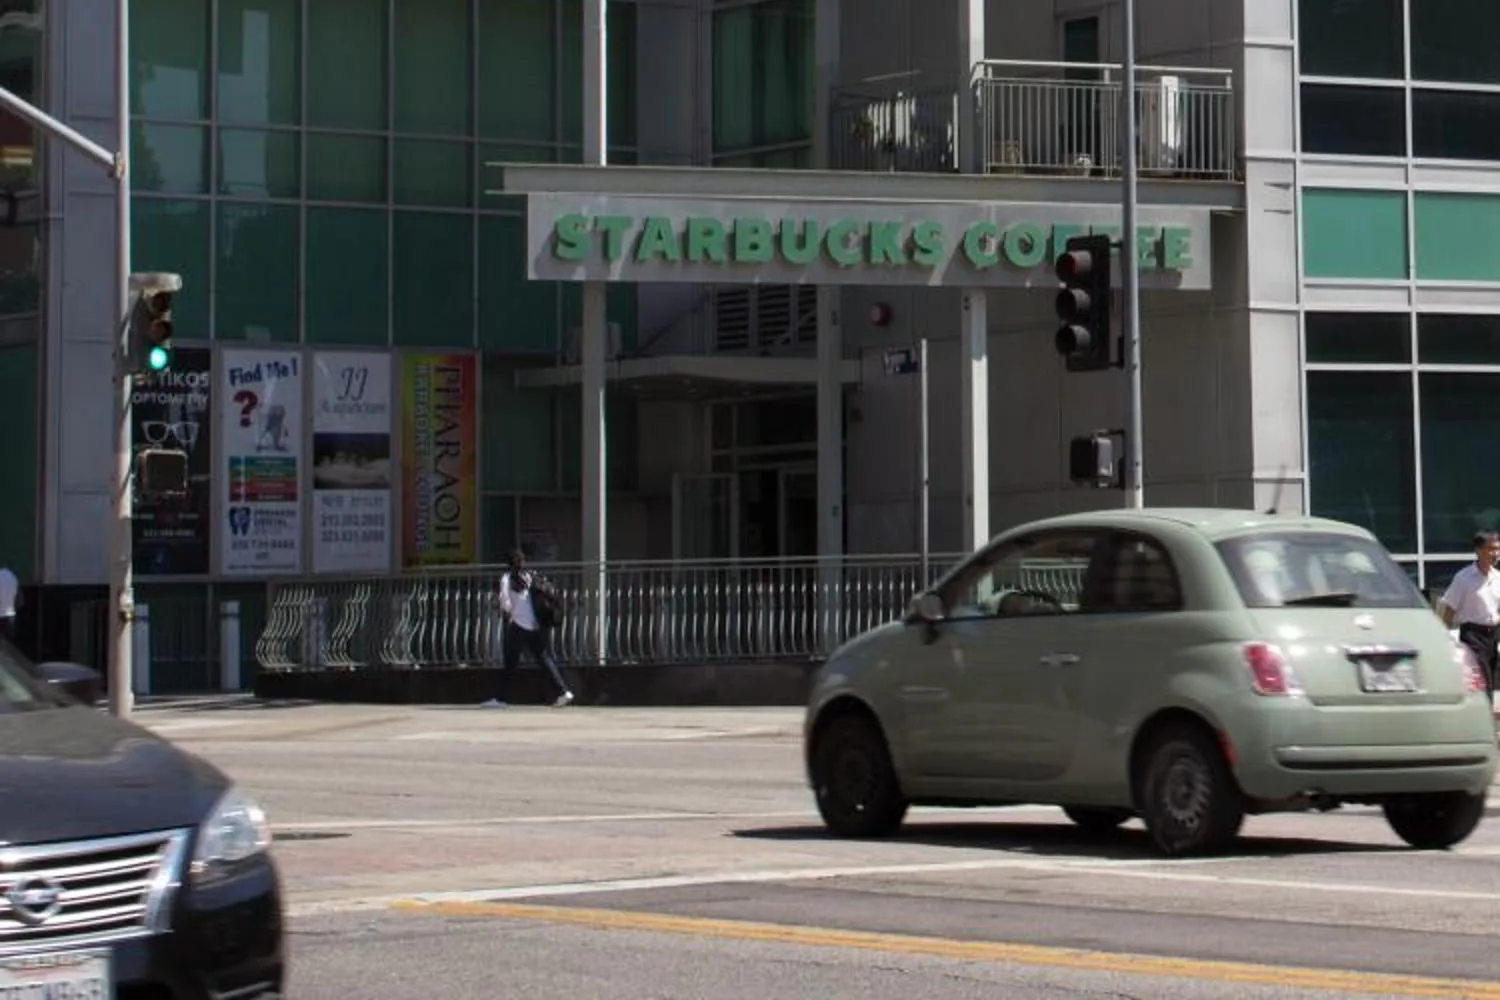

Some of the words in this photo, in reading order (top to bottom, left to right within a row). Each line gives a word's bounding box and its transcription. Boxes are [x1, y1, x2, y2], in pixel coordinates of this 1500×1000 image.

[554, 212, 945, 268] STARBUCKS
[229, 361, 262, 387] Find
[434, 365, 462, 552] PHARAOH
